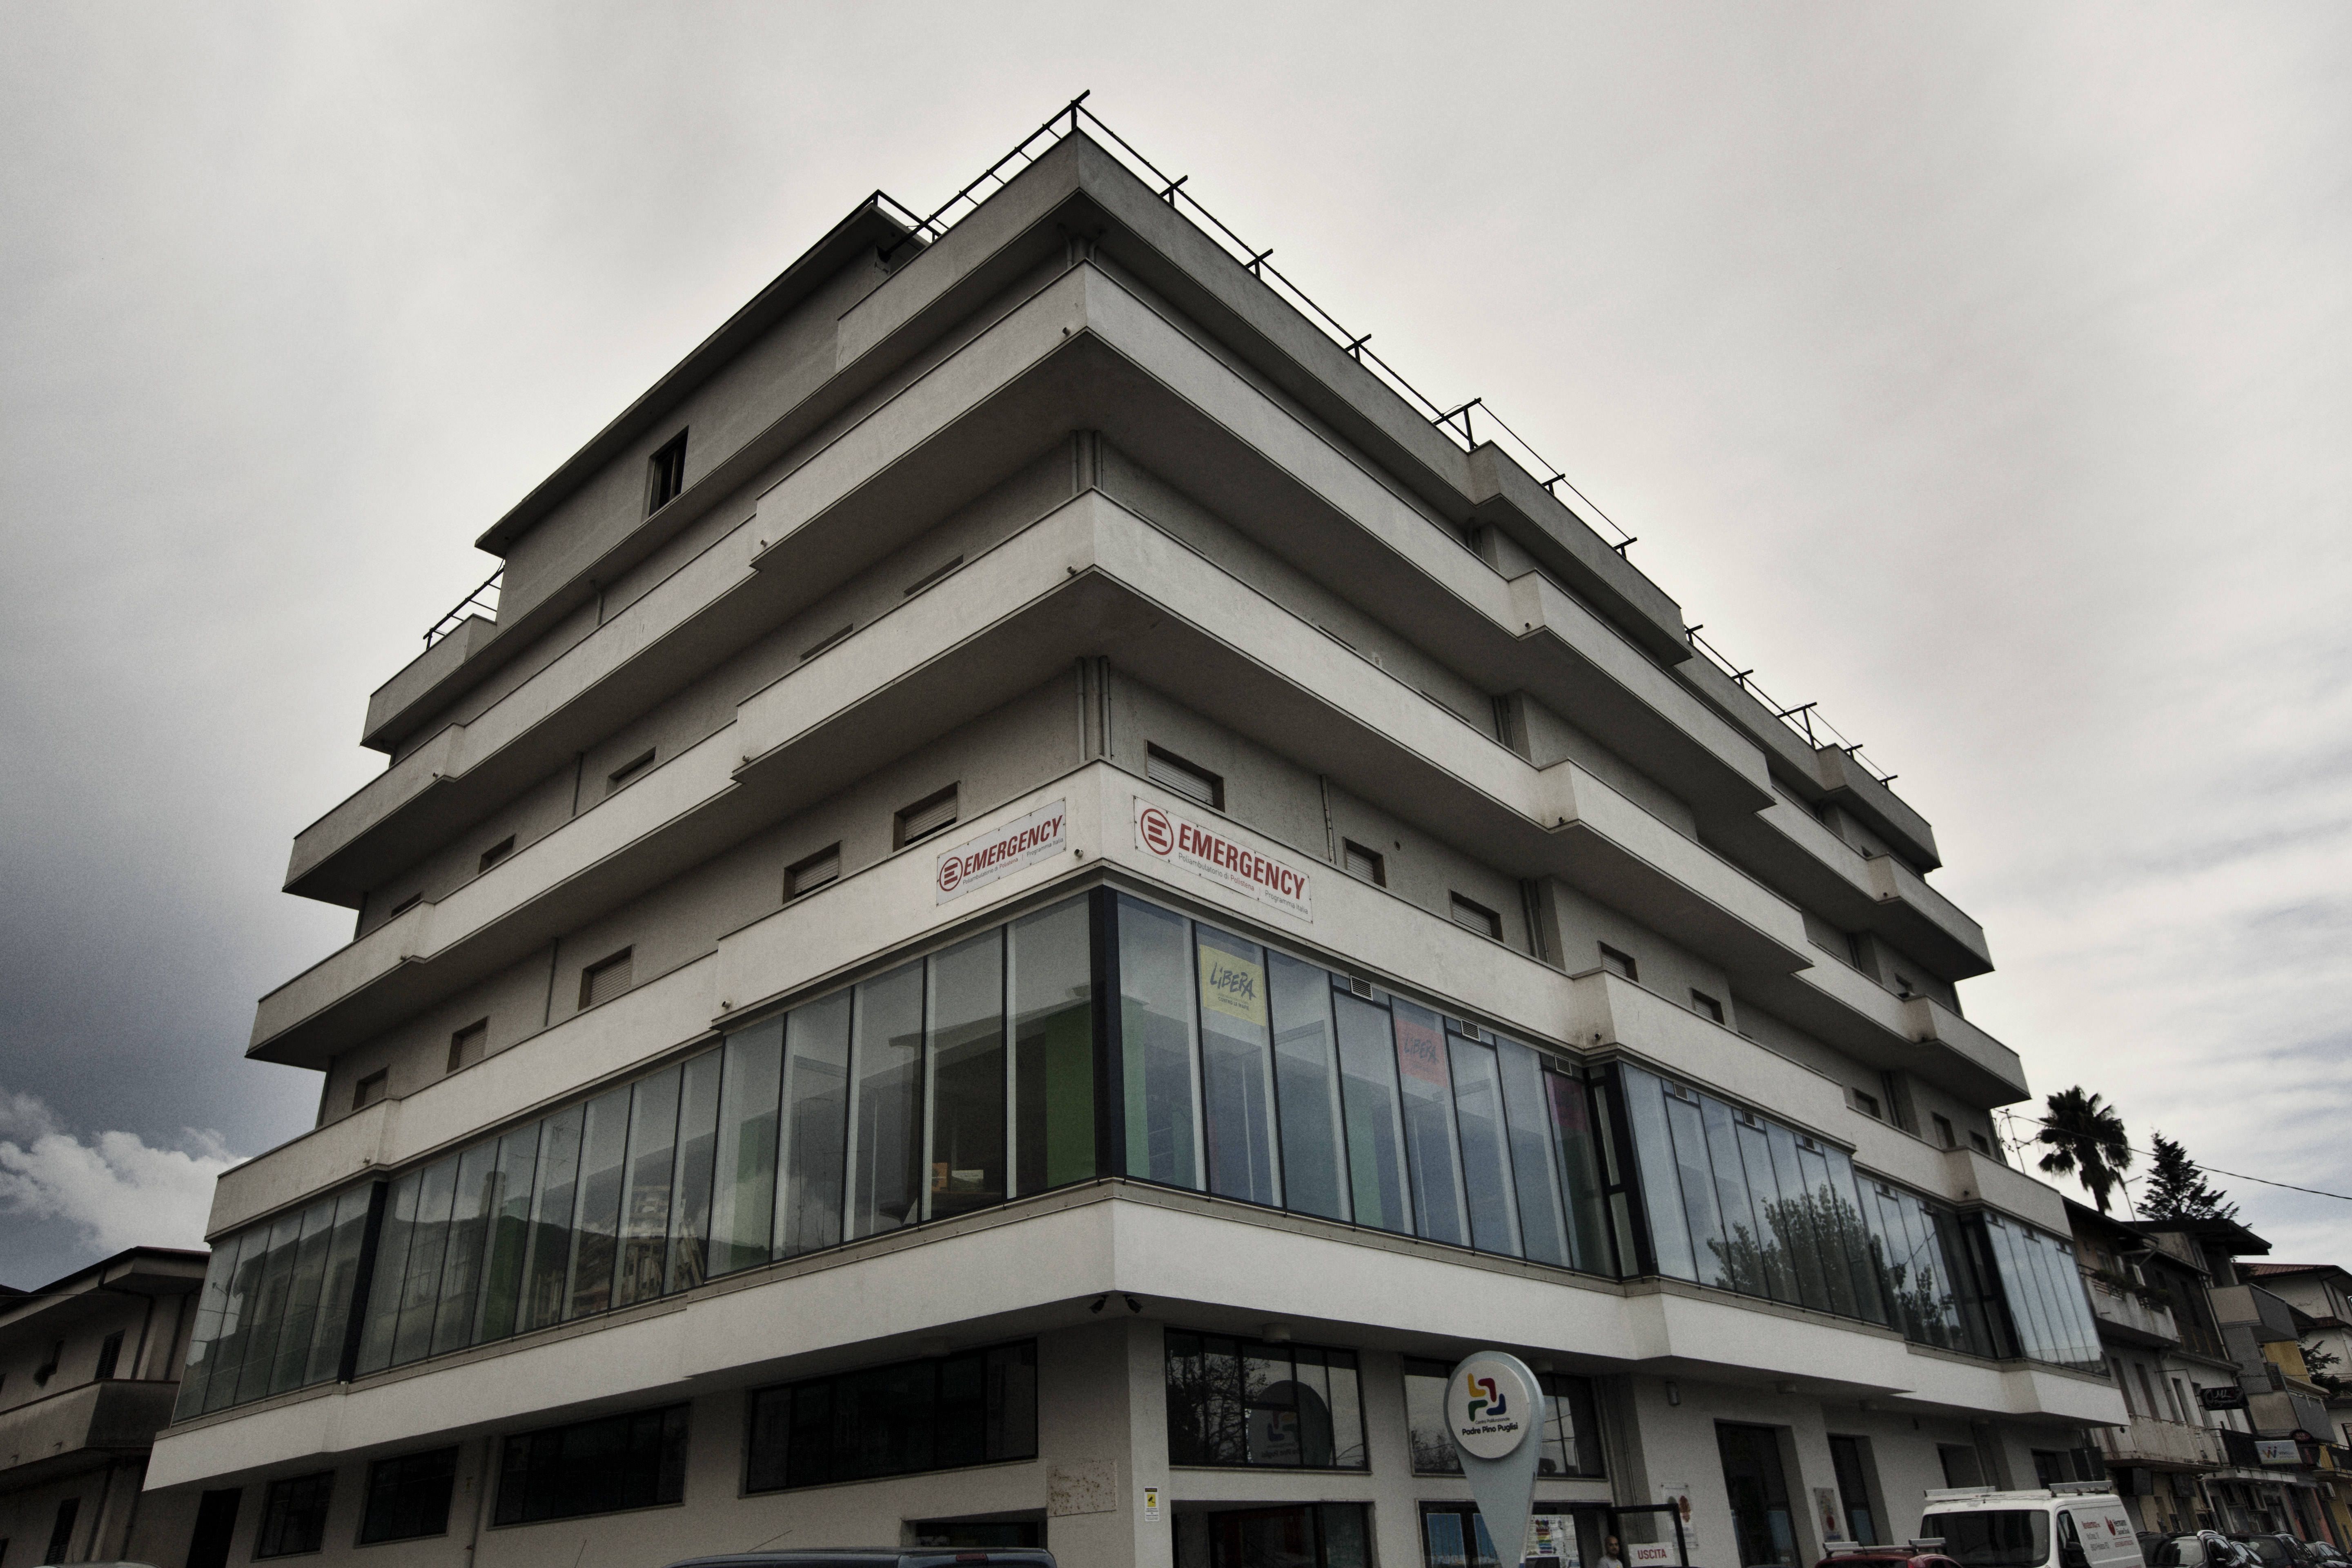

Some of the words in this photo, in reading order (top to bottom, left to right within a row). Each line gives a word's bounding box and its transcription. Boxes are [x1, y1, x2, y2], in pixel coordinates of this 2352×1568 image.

[962, 868, 993, 885] Poliambulatorio
[999, 858, 1018, 869] Polistena
[1027, 843, 1052, 857] Programma
[1053, 838, 1064, 846] Italia
[963, 815, 1062, 877] EMERGENCY
[1178, 823, 1305, 900] EMERGENCY
[1178, 853, 1223, 878] Poliambulatorio
[1224, 872, 1229, 880] di
[1230, 875, 1254, 891] Polistena
[1265, 890, 1295, 909] Programma
[1296, 902, 1308, 915] Italia
[1218, 996, 1233, 1005] CONTRO
[1462, 1427, 1481, 1436] Padre
[1497, 1422, 1518, 1432] Puglisi
[1637, 1548, 1667, 1559] USCITA
